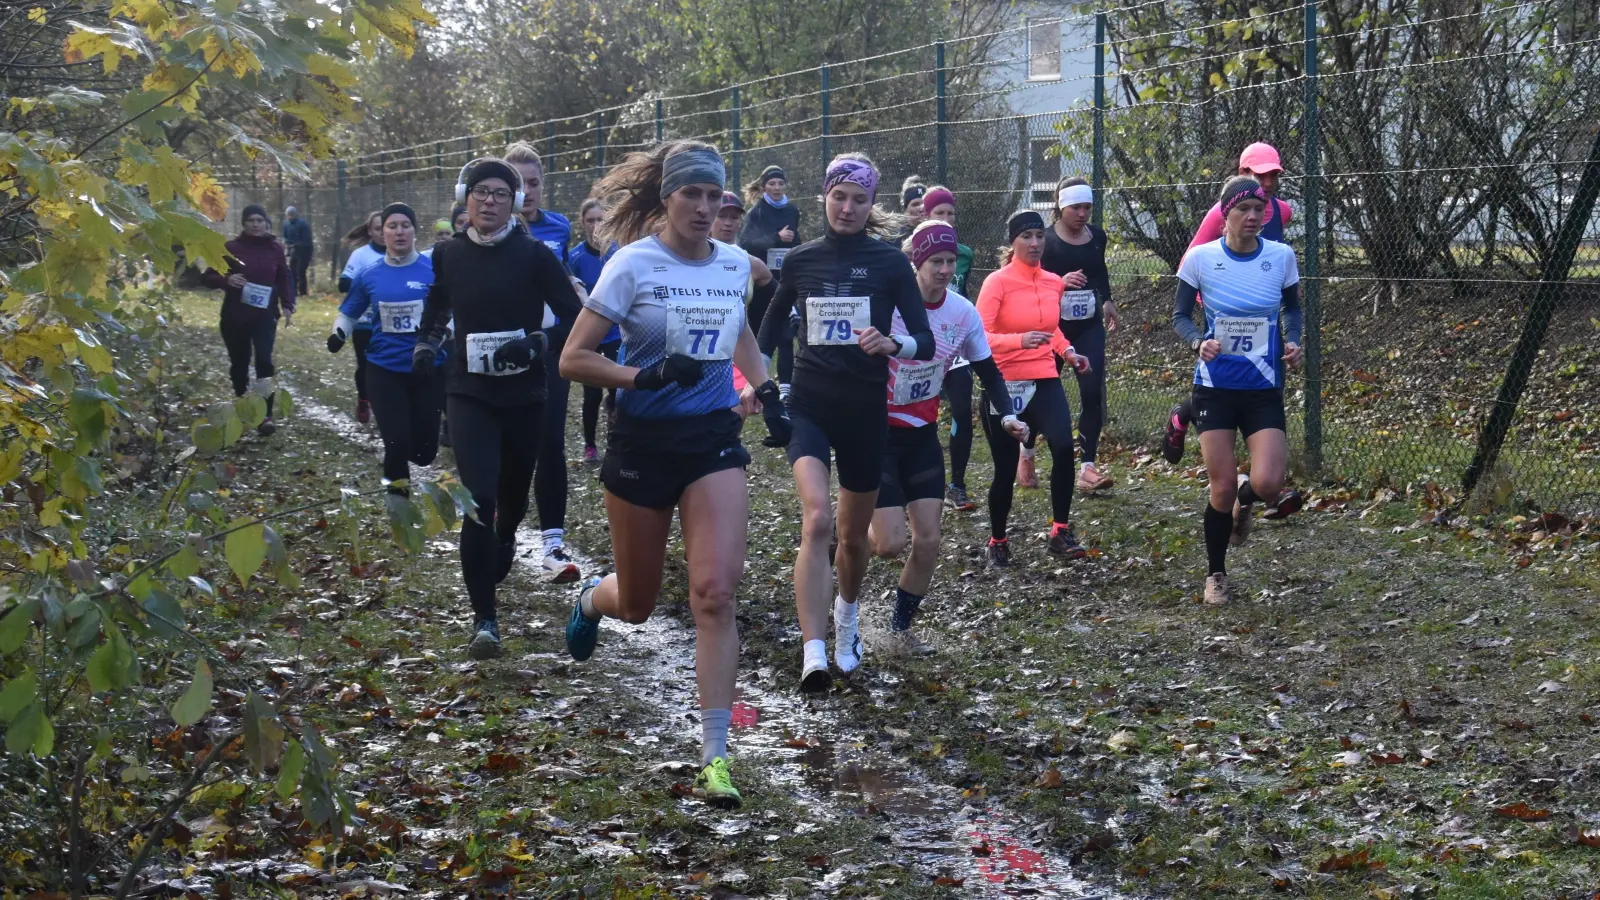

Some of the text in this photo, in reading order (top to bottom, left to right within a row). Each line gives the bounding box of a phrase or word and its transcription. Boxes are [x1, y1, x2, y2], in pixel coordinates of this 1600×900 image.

[670, 288, 702, 297] TELIS
[251, 295, 264, 306] 92
[811, 301, 863, 309] Feuchtwanger
[675, 305, 733, 316] Feuchtwanger
[1072, 304, 1088, 317] 85
[392, 316, 412, 330] 83
[685, 317, 726, 325] Crosslauf
[823, 319, 852, 341] 79
[688, 329, 720, 355] 77
[1230, 335, 1253, 353] 75
[910, 380, 932, 399] 82
[1013, 396, 1023, 411] 0
